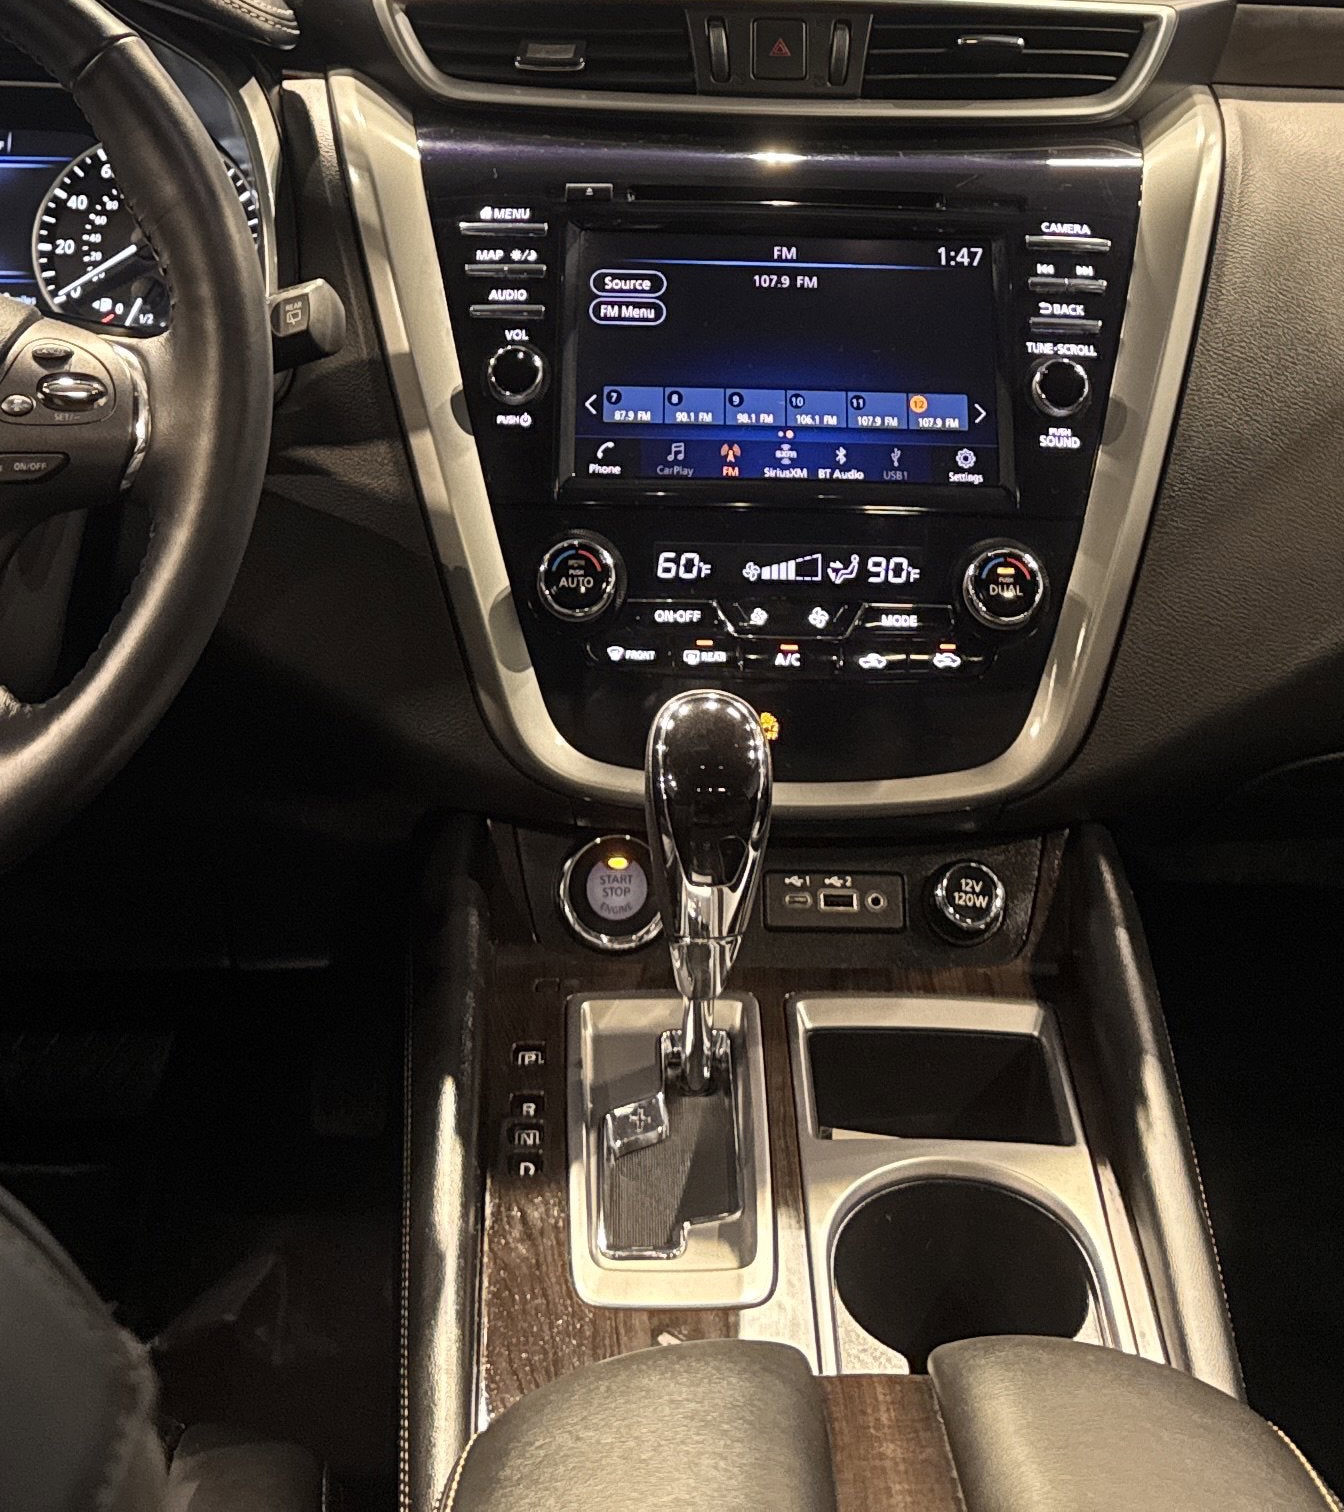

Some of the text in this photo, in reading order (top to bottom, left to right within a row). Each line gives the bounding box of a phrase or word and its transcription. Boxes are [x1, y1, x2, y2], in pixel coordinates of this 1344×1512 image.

[66, 195, 88, 210] 40
[493, 208, 531, 220] MENU
[1041, 222, 1091, 235] CAMERA
[55, 239, 75, 255] 20
[773, 246, 797, 260] FM
[476, 250, 504, 261] MAP
[937, 246, 983, 267] 1:47
[604, 276, 652, 291] Source
[753, 274, 818, 289] 107.9 FM
[488, 289, 528, 301] AUDIO
[285, 301, 303, 311] REAR
[600, 305, 655, 319] FM Menu
[1053, 304, 1085, 316] BACK
[139, 313, 154, 325] 1/2
[504, 329, 530, 341] VOL
[610, 392, 617, 402] 7
[671, 393, 678, 404] 8
[732, 395, 740, 405] 9
[791, 396, 804, 407] 10
[851, 398, 865, 409] 11
[913, 399, 925, 410] 12
[496, 415, 520, 425] PUSH
[614, 410, 651, 421] 87.9 FM
[699, 412, 712, 423] FM
[759, 413, 774, 424] FM
[823, 415, 837, 426] FM
[858, 416, 898, 428] 107.9 FM
[918, 417, 959, 429] 107.9 FM
[1048, 427, 1072, 437] PUSH
[1039, 435, 1081, 449] SOUND
[13, 462, 48, 471] ON/OFF
[589, 463, 622, 475] Phone
[657, 465, 694, 477] CarPlay
[723, 466, 739, 477] FM
[764, 467, 808, 478] SiriusXM
[818, 468, 864, 480] BT Audio
[883, 470, 908, 481] USB1
[948, 471, 983, 484] Settings
[558, 576, 594, 588] AUTO
[998, 576, 1014, 584] PUSH
[989, 584, 1024, 597] DUAL
[880, 614, 918, 628] MODE
[625, 650, 656, 661] FRONT
[700, 651, 727, 662] REAR
[774, 653, 801, 667] A/C
[600, 874, 633, 885] START
[805, 875, 811, 887] 1
[845, 876, 852, 887] 2
[960, 878, 983, 894] 12V
[602, 887, 631, 898] STOP
[953, 892, 989, 909] 120W
[600, 901, 633, 914] ENGINE
[524, 1053, 537, 1066] P
[522, 1102, 536, 1117] R
[520, 1133, 534, 1145] N
